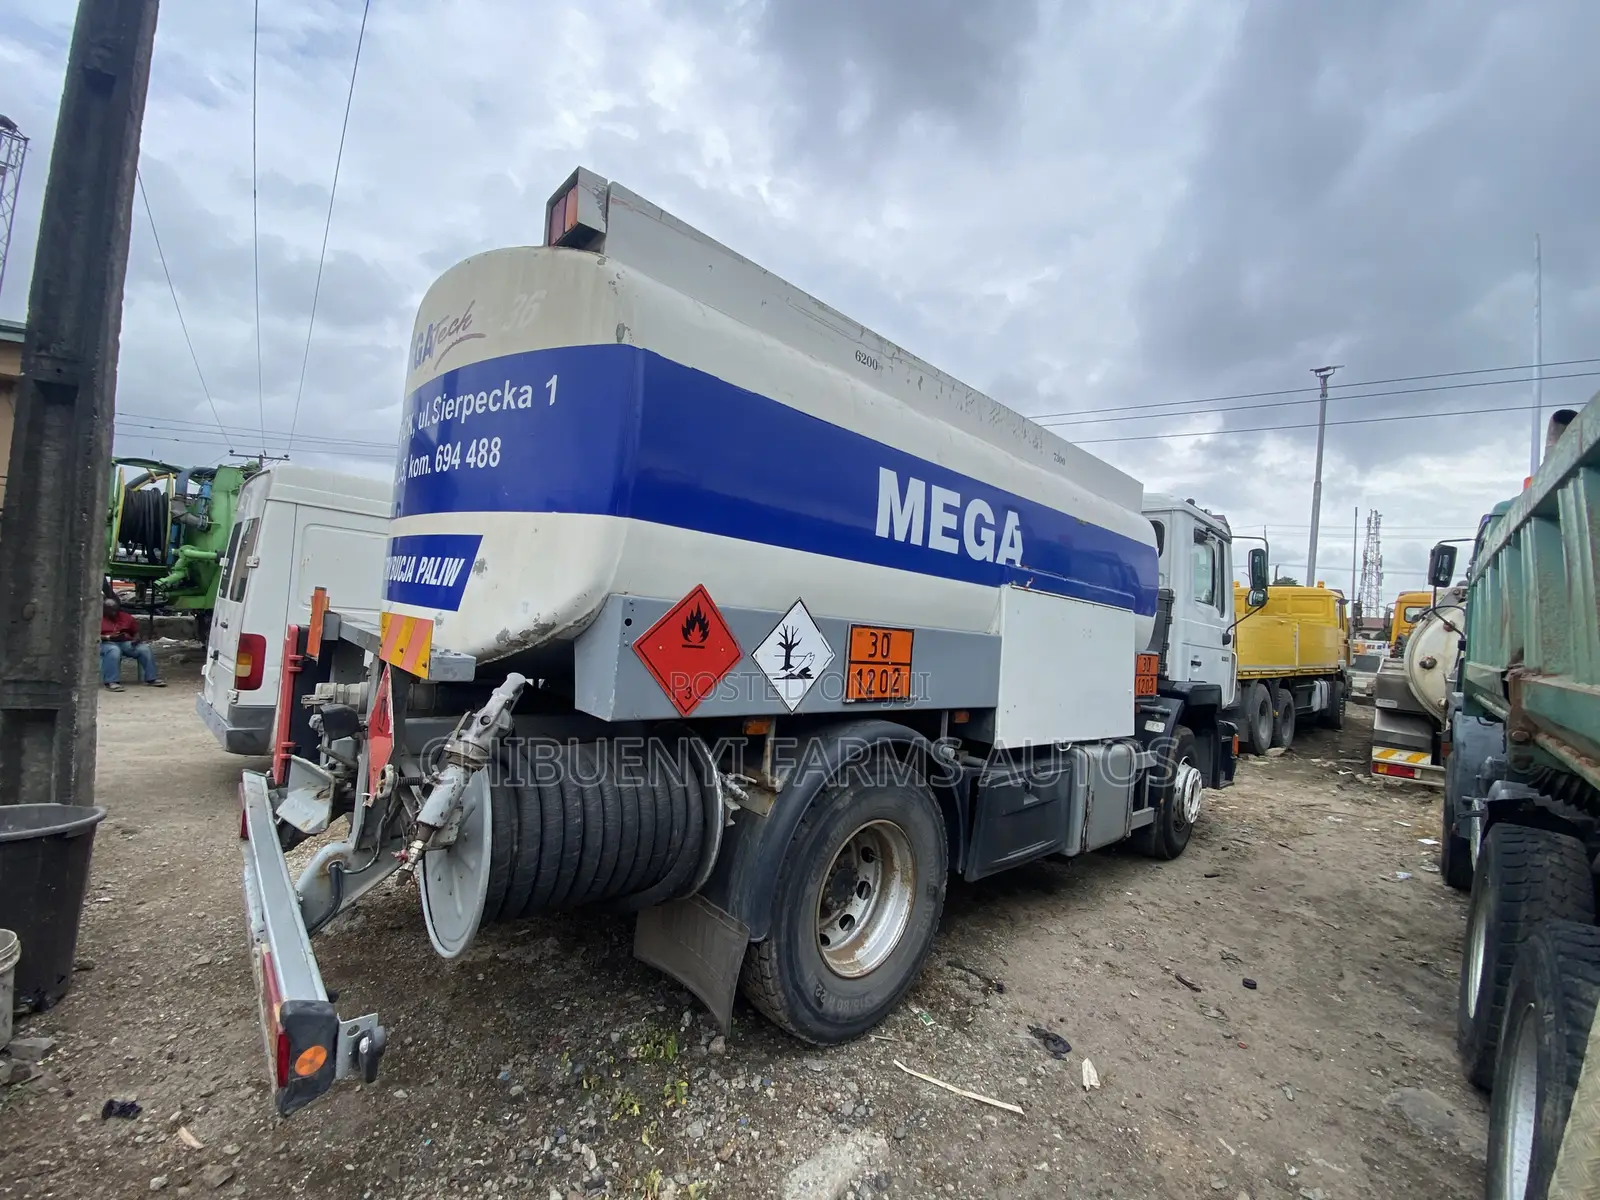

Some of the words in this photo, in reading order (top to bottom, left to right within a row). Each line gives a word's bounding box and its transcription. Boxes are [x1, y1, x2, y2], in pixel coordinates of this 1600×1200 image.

[854, 350, 878, 372] 6200
[545, 374, 558, 406] 1
[408, 453, 431, 479] kom.
[435, 441, 461, 472] 694
[466, 437, 501, 469] 488
[875, 466, 1024, 567] MEGA
[415, 557, 465, 587] PALIW
[868, 632, 892, 658] 30
[684, 687, 693, 700] 3
[856, 667, 901, 695] 1202
